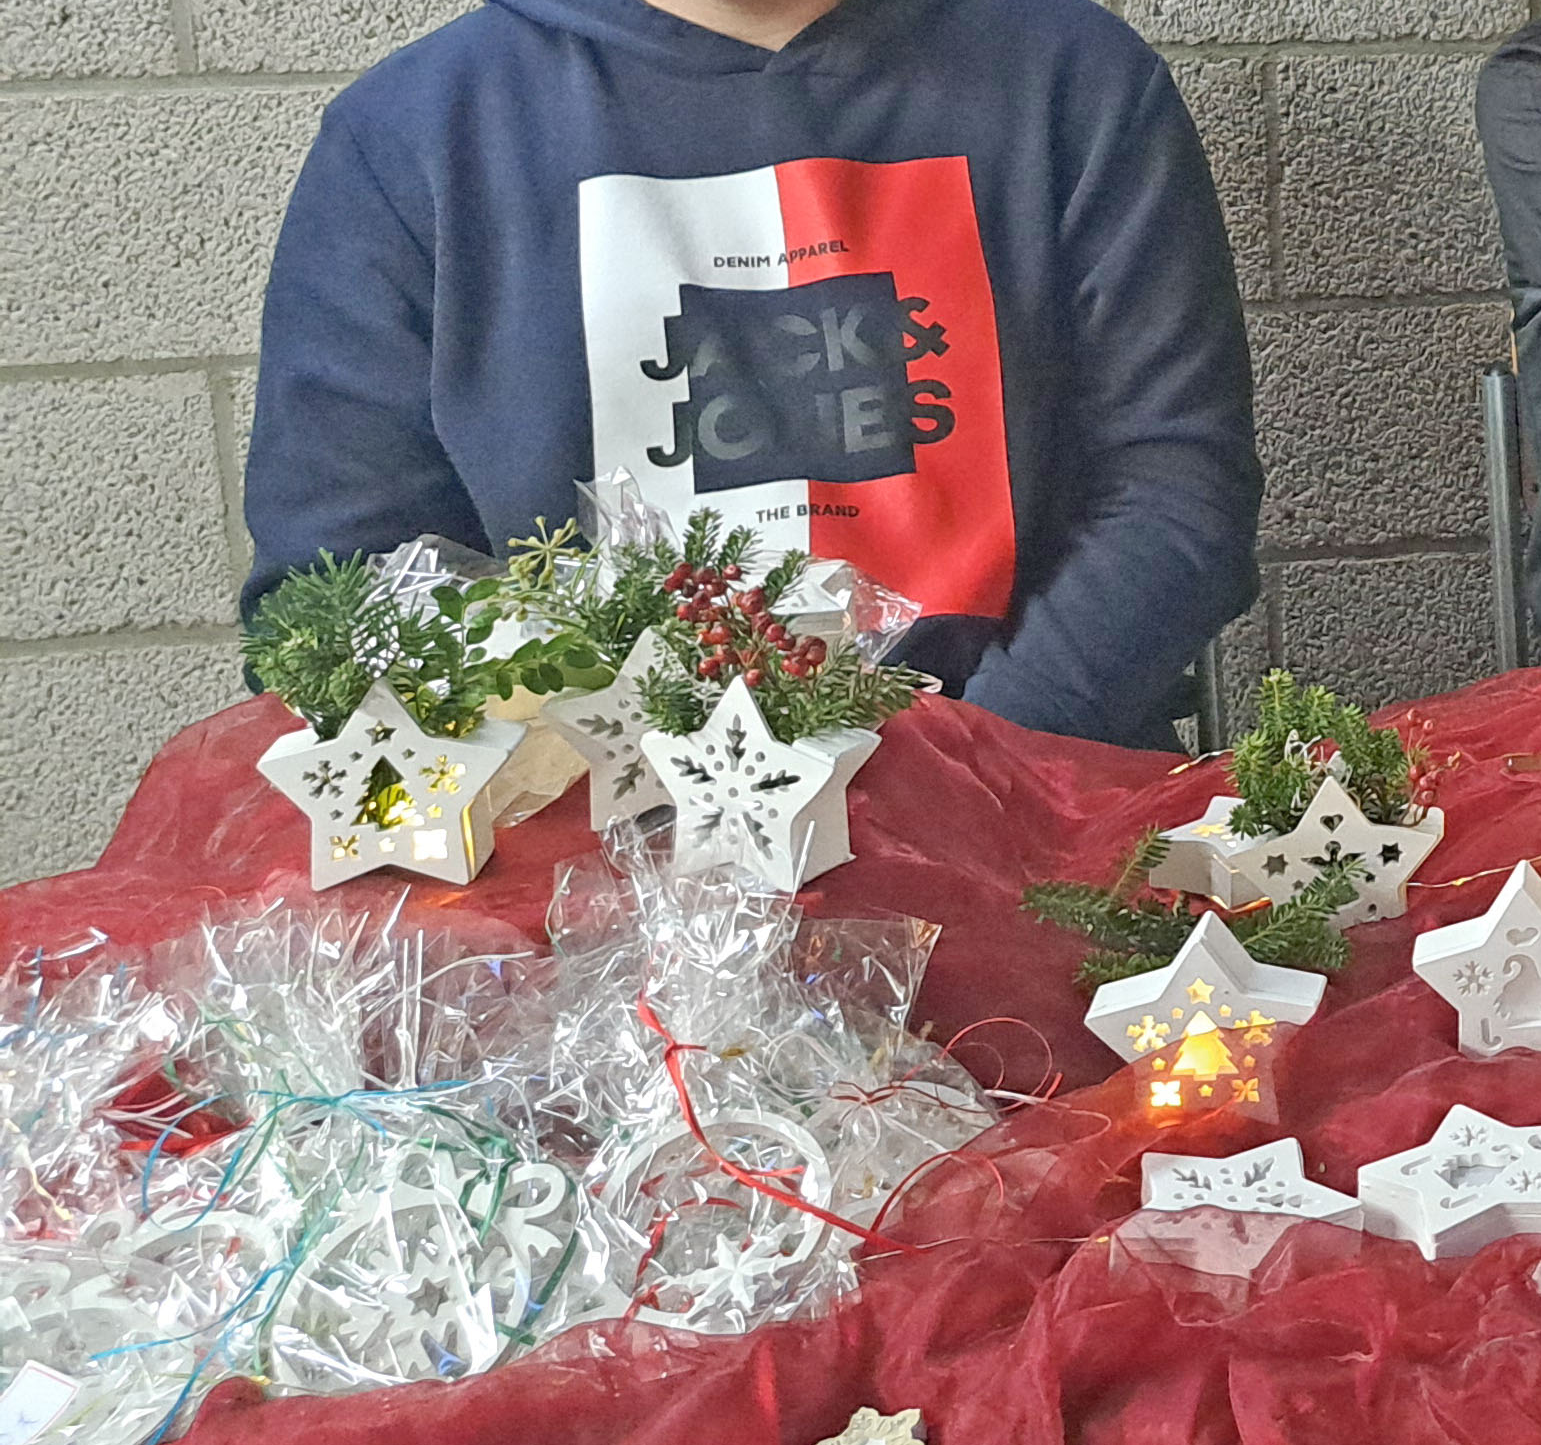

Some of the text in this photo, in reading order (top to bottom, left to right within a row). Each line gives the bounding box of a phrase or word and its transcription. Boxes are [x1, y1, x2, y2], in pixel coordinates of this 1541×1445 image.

[713, 240, 849, 269] DENIM APPAREL
[756, 504, 860, 524] THE BRAND
